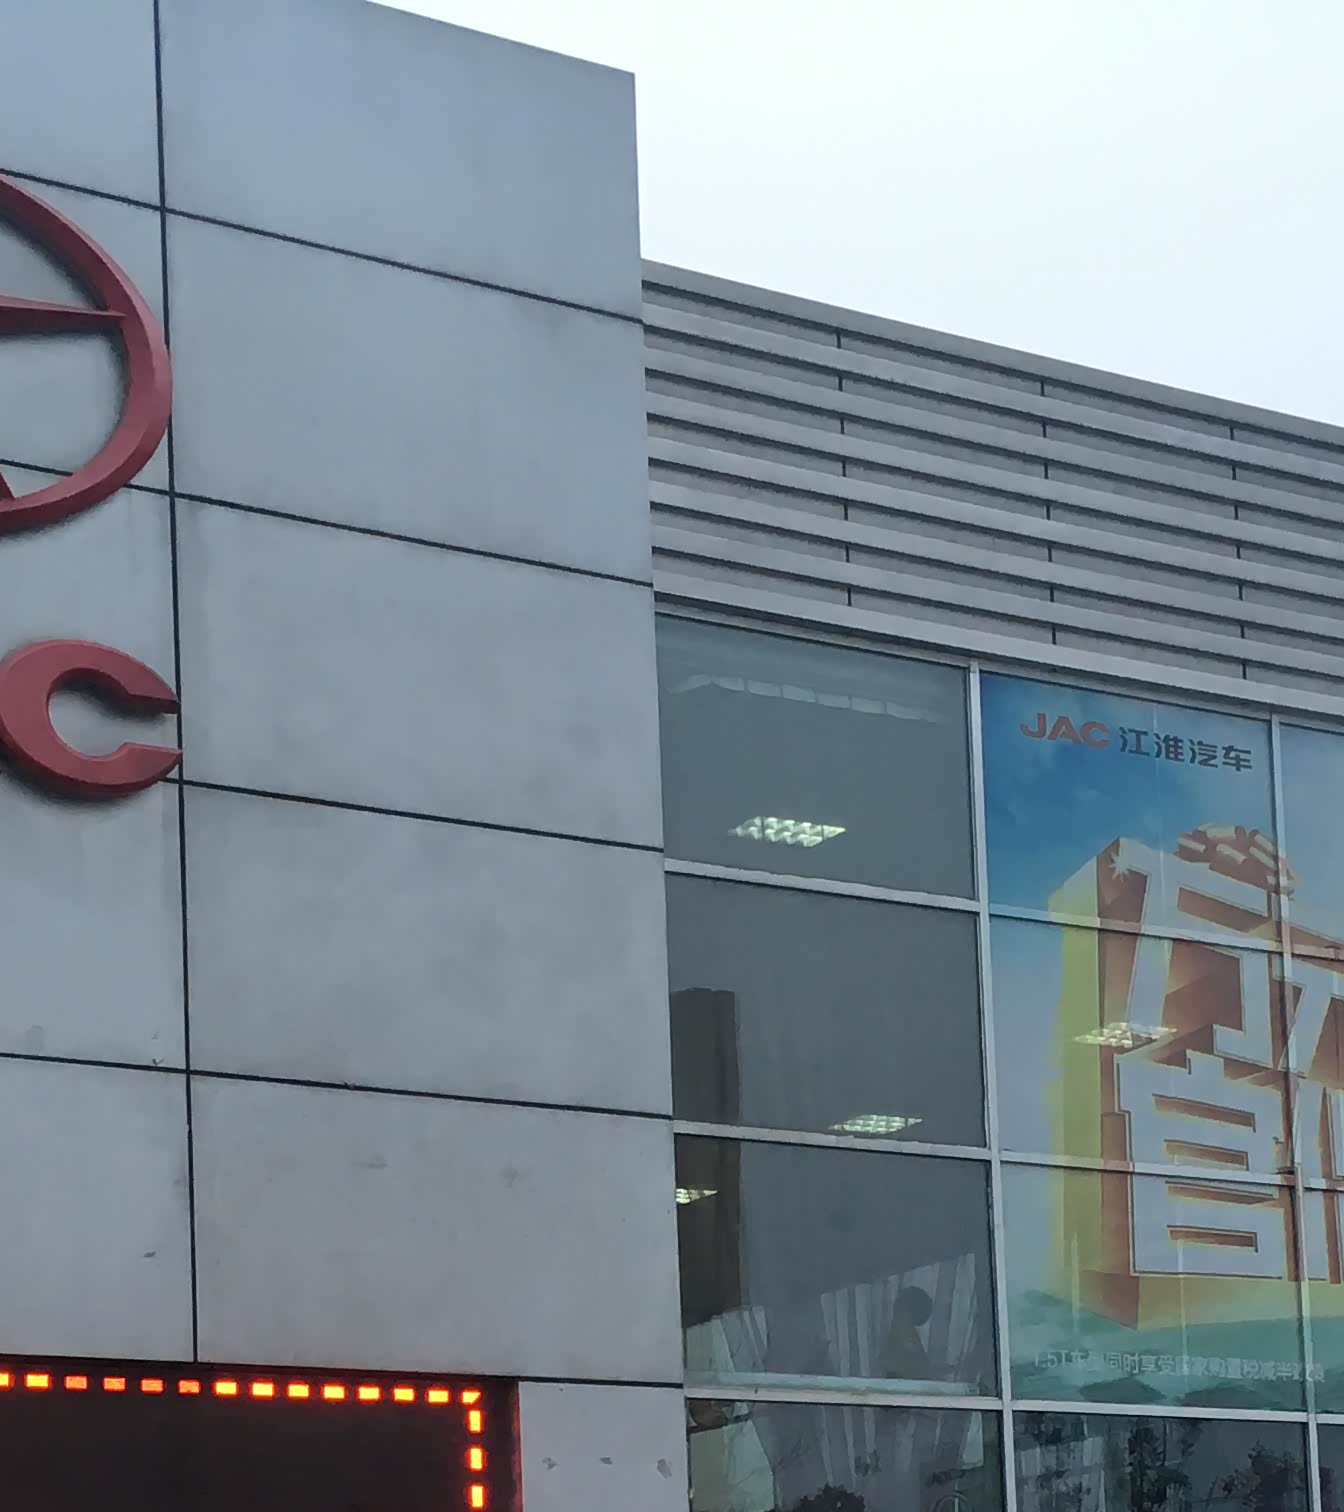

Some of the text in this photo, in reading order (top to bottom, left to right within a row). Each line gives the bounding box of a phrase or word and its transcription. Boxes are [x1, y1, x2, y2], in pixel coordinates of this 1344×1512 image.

[1019, 713, 1254, 772] JAC 江淮汽车
